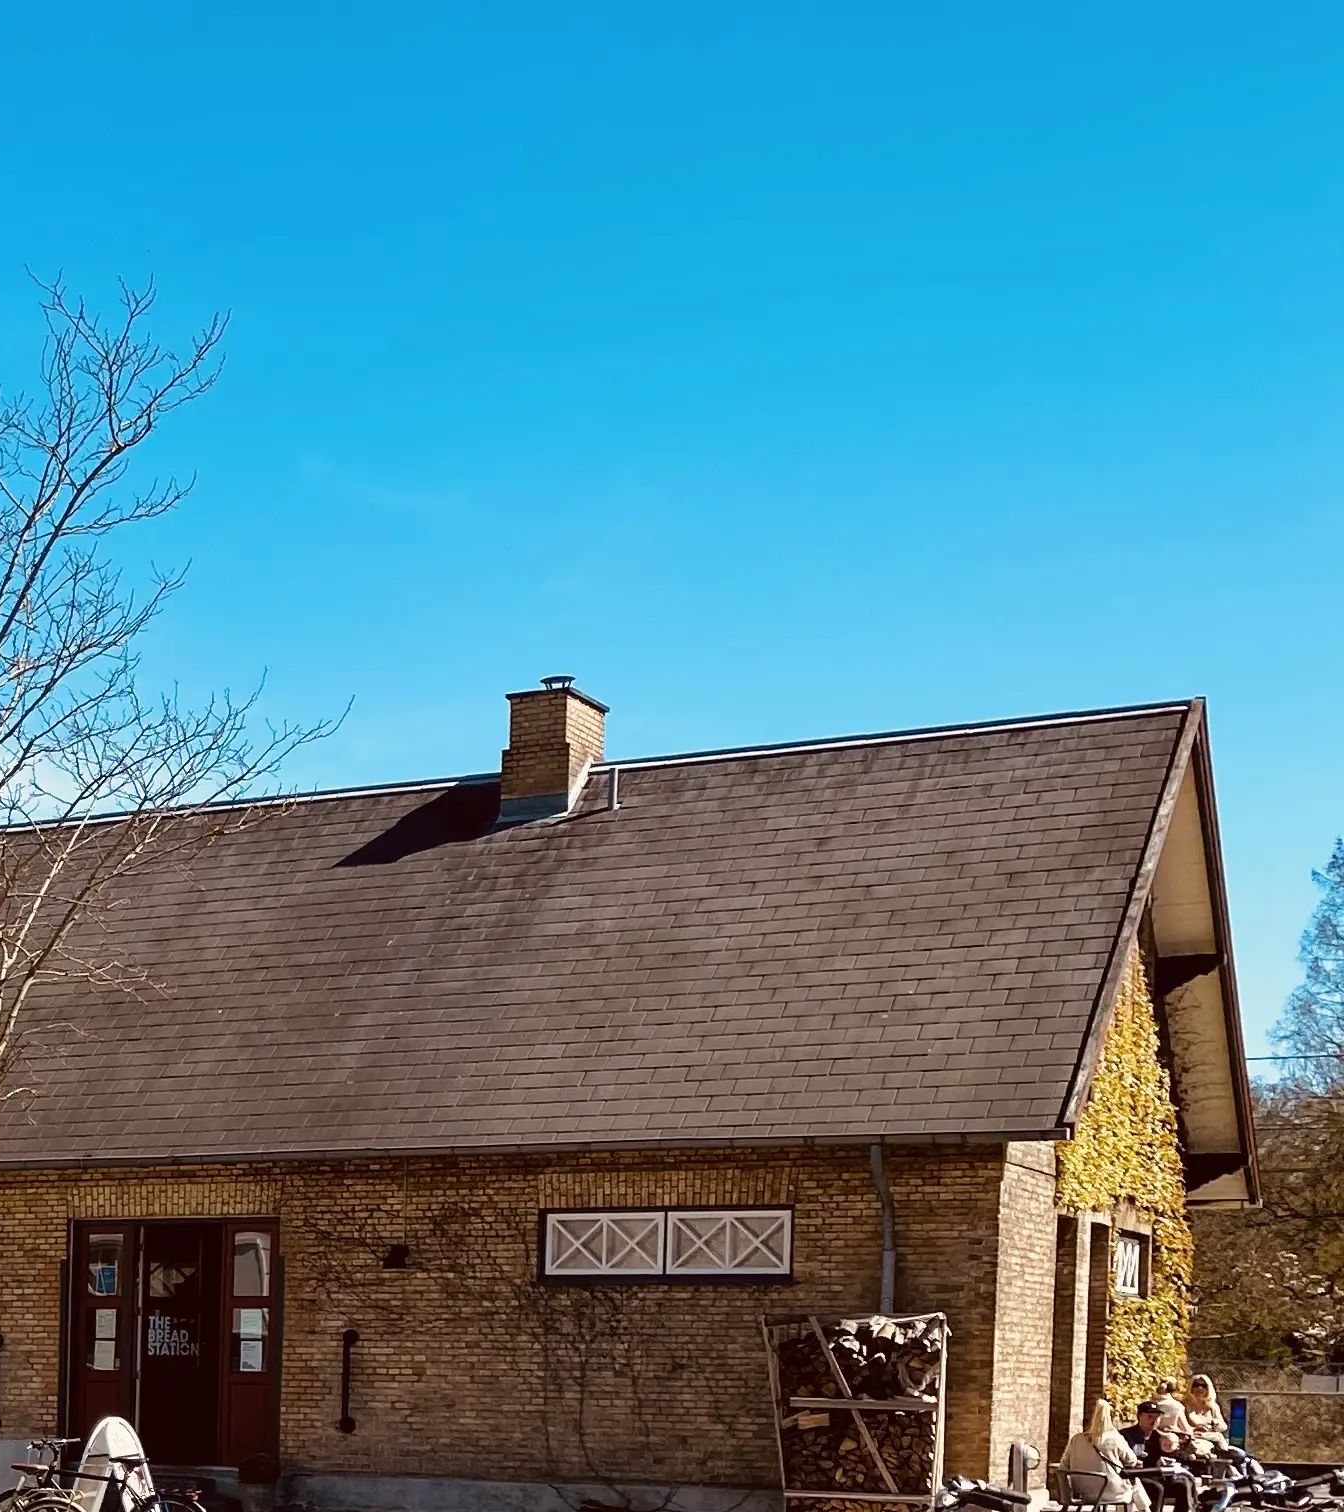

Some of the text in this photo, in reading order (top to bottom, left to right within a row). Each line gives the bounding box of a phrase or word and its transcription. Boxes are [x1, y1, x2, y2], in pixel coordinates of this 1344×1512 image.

[148, 1316, 171, 1329] THE
[148, 1329, 189, 1342] BREAD
[148, 1342, 200, 1356] STATION
